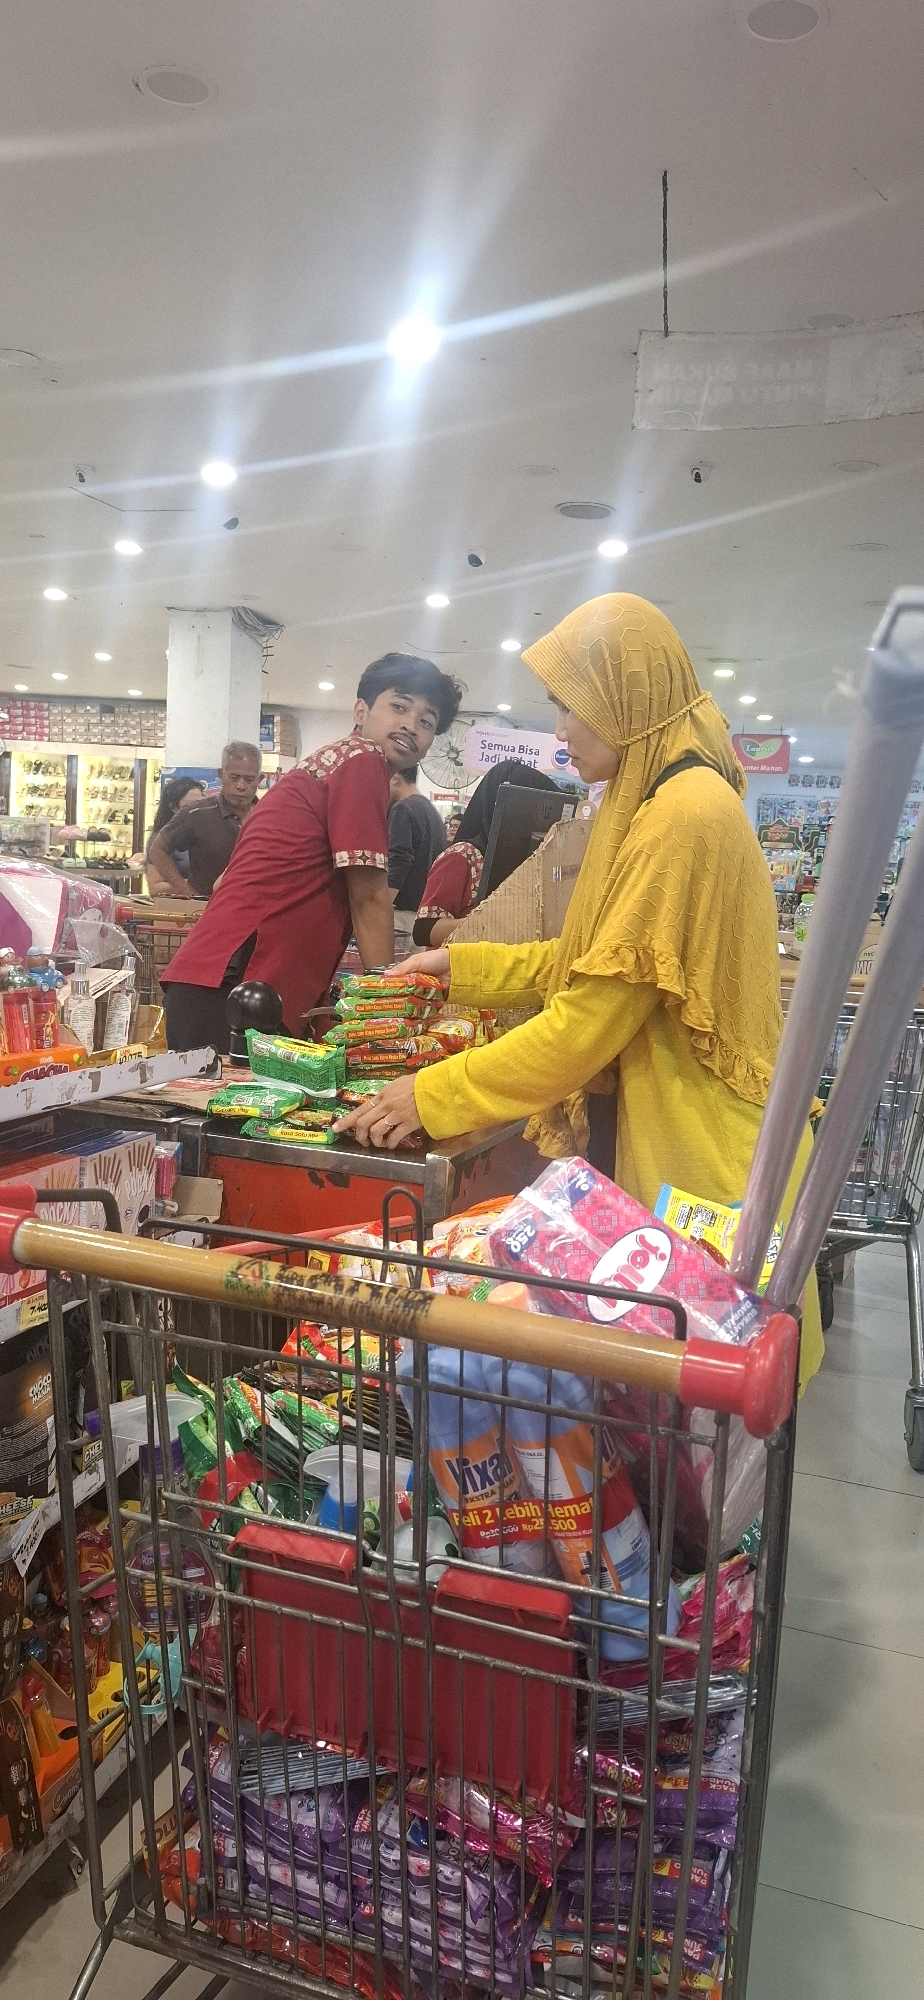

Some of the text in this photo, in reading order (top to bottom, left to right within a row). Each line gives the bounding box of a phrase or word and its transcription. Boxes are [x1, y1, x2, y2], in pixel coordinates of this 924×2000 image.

[480, 739, 540, 756] Semua Bisa
[479, 751, 501, 763] Jadi
[760, 764, 783, 772] Mainan
[465, 1490, 498, 1504] EKSTRA
[0, 1496, 34, 1514] HEESE
[482, 1509, 495, 1524] 2
[709, 1783, 736, 1793] PACK
